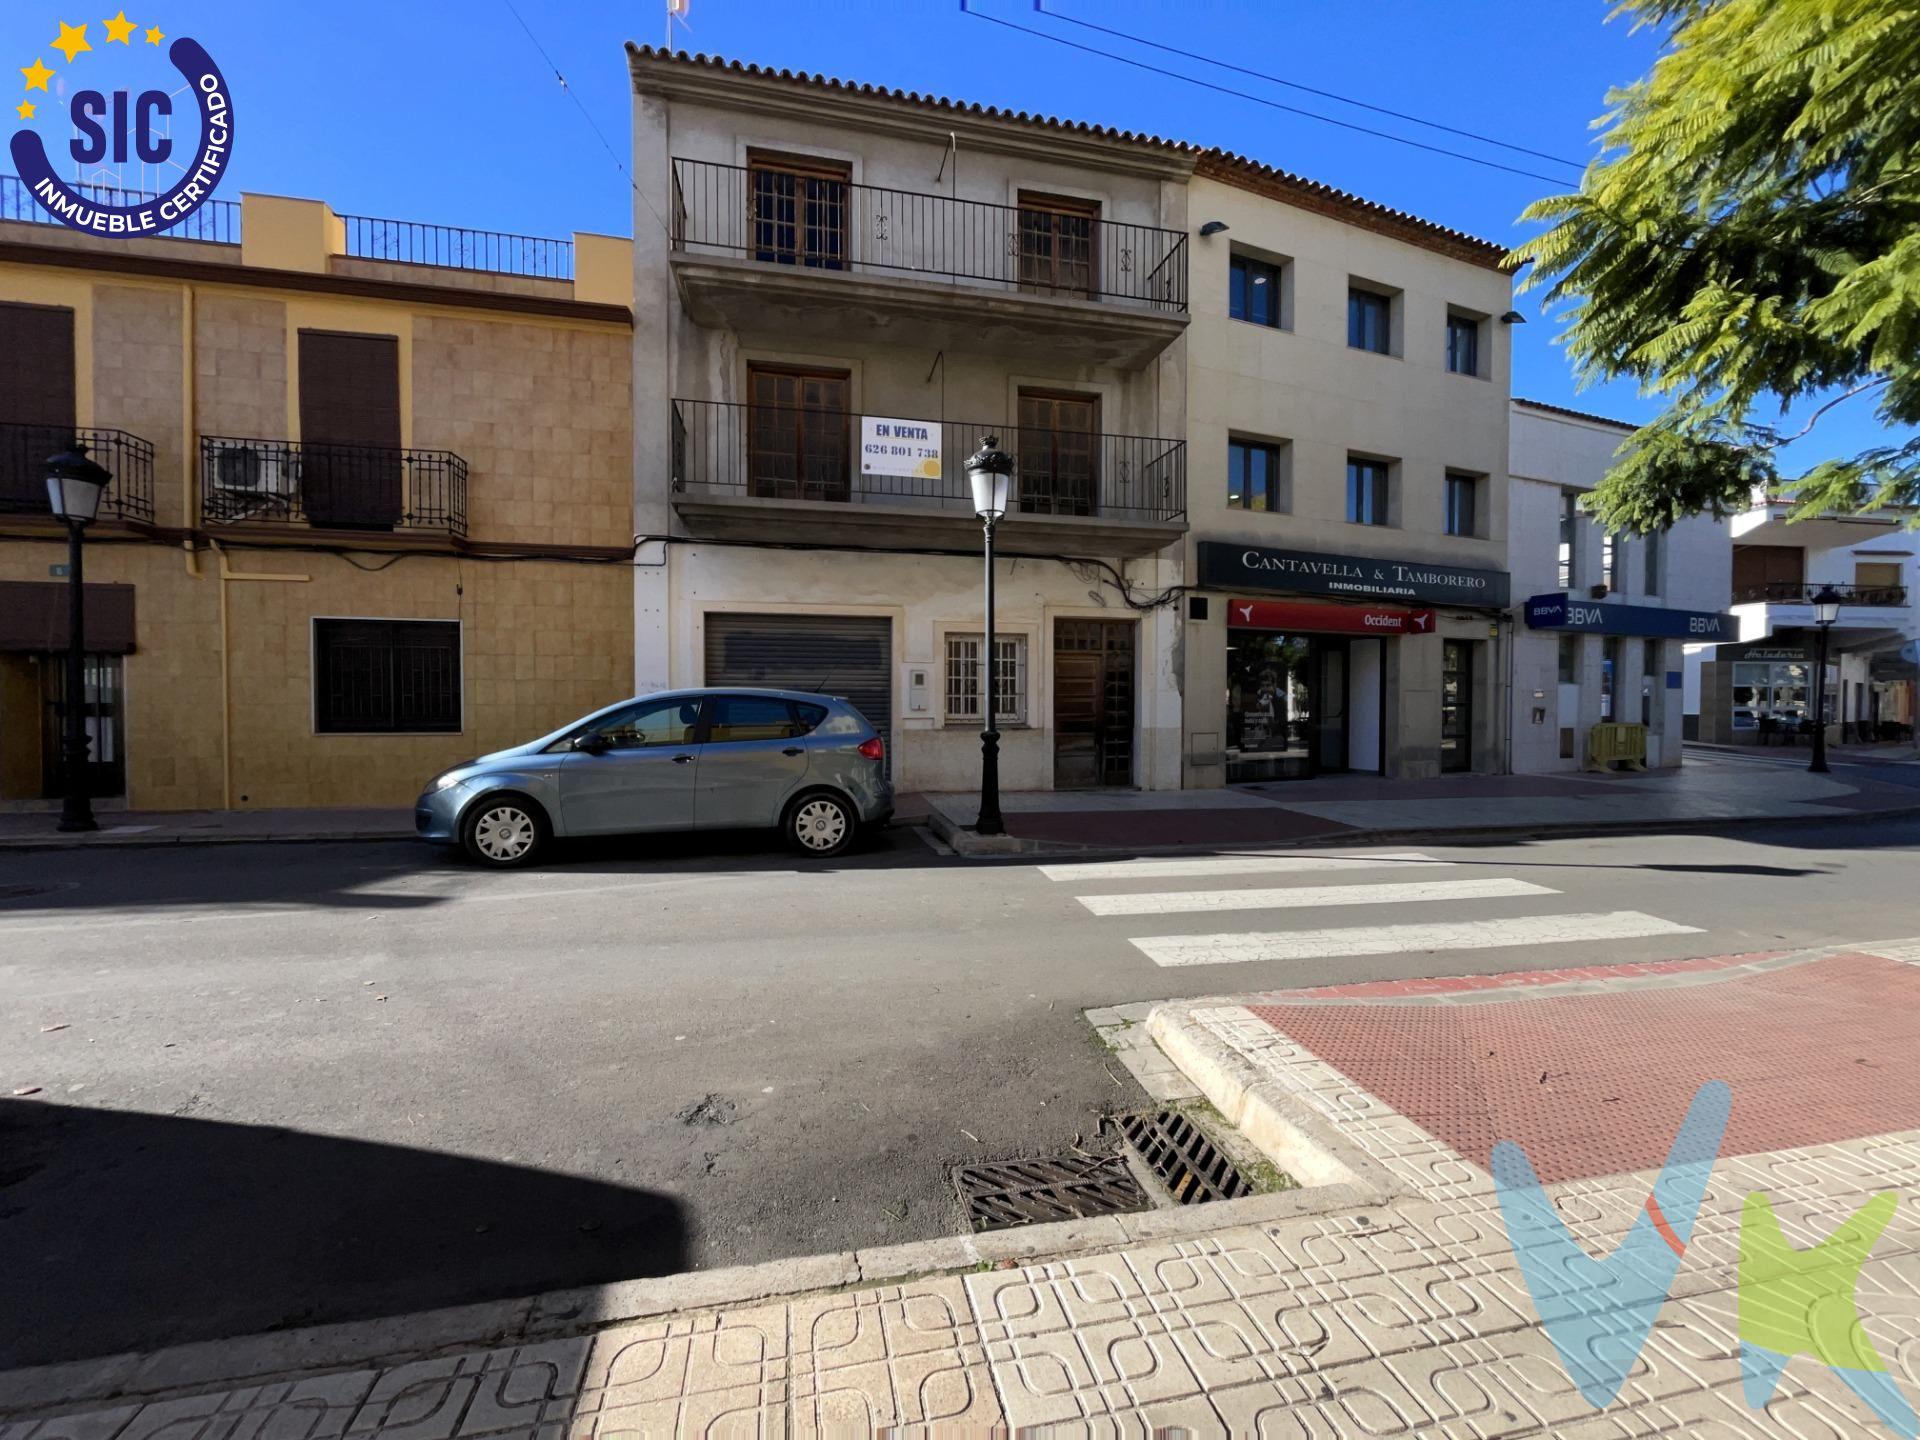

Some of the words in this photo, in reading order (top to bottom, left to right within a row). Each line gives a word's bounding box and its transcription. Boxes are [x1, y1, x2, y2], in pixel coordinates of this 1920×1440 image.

[875, 424, 890, 437] EN
[894, 425, 928, 440] VENTA
[864, 444, 888, 455] 626
[917, 448, 939, 459] 738
[1242, 551, 1364, 578] CANTAVELLA
[1373, 569, 1385, 580] &
[1391, 565, 1487, 589] TAMBORERO
[1328, 582, 1417, 596] INMOBILIARIA
[1533, 605, 1563, 617] BBVA
[1364, 614, 1402, 627] Occident
[1690, 617, 1721, 633] BBVA
